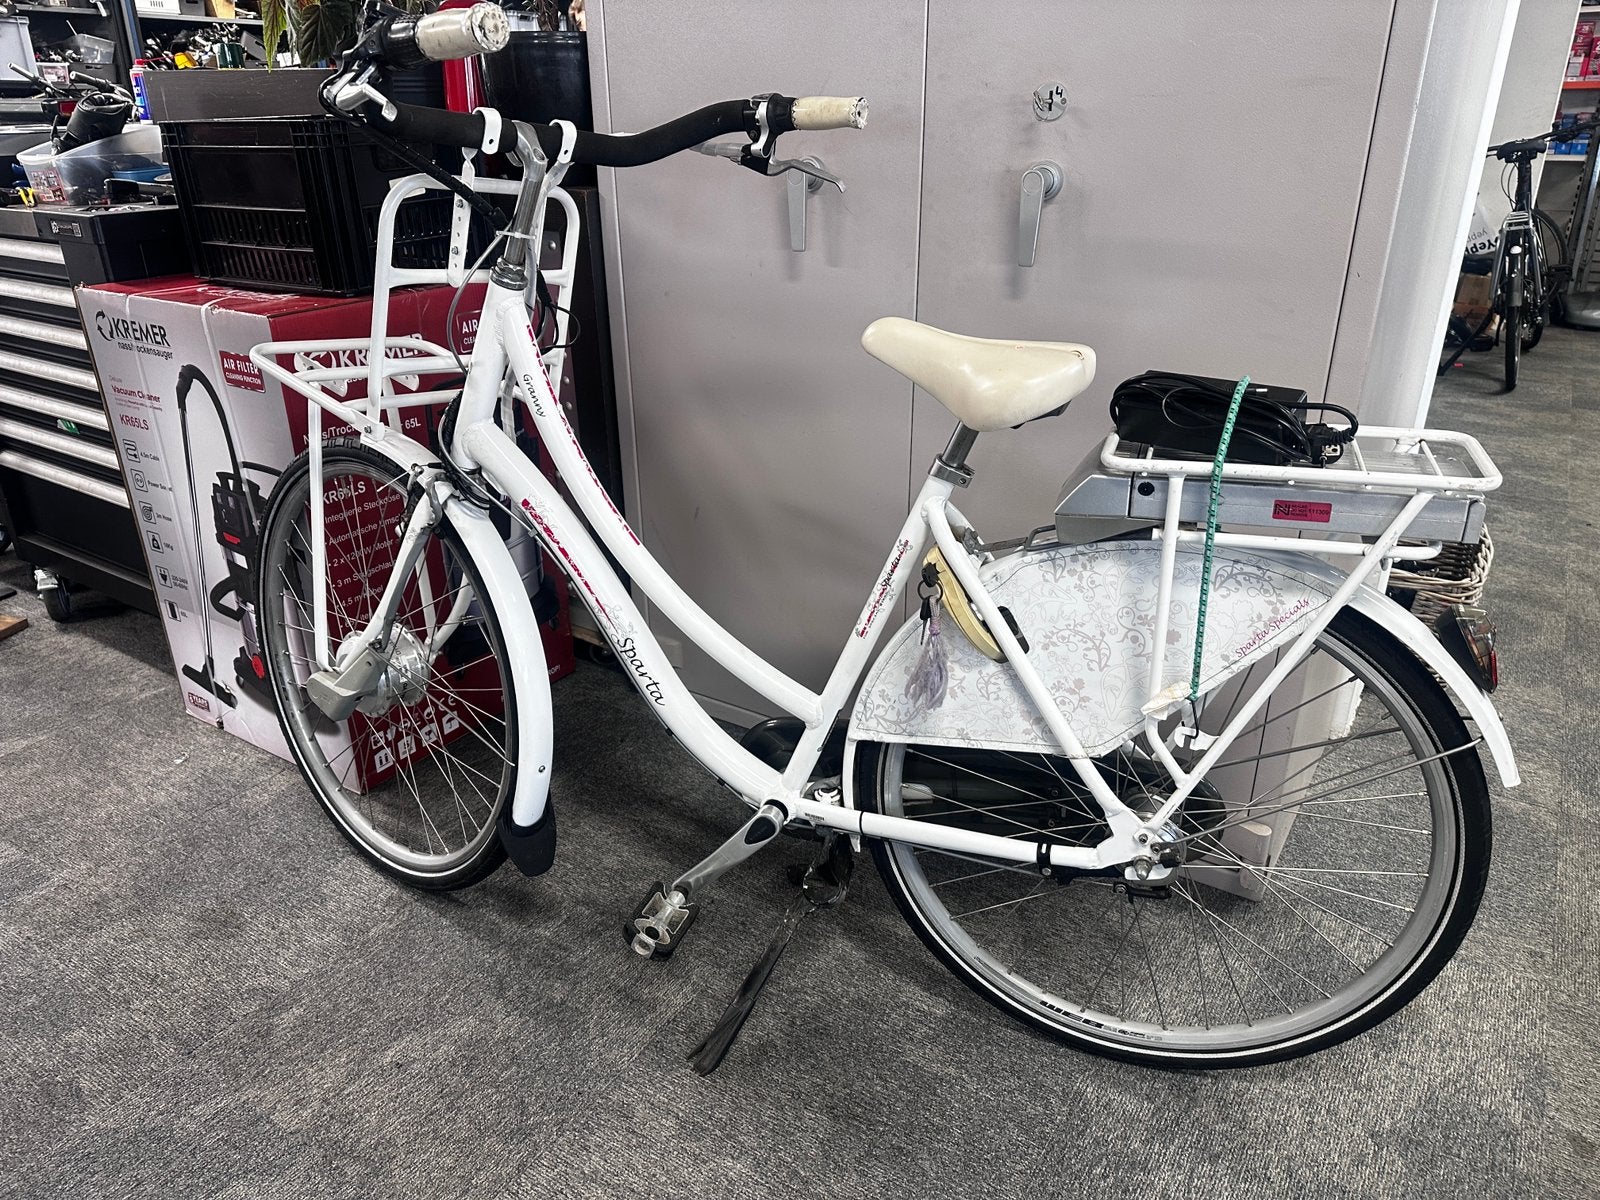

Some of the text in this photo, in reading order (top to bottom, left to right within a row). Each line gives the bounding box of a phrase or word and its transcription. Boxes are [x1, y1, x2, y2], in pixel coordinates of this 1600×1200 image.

[111, 317, 171, 347] KREMER
[461, 319, 479, 334] AIR
[223, 357, 260, 375] AIR FILTER
[111, 385, 137, 398] Vacuum
[523, 373, 547, 418] Granny
[119, 413, 149, 430] KR65LS
[404, 417, 421, 430] 65L
[333, 558, 338, 567] 2
[336, 579, 343, 588] 3
[344, 575, 352, 585] m
[1234, 597, 1310, 658] Sparta Specials
[612, 634, 666, 706] Sparta
